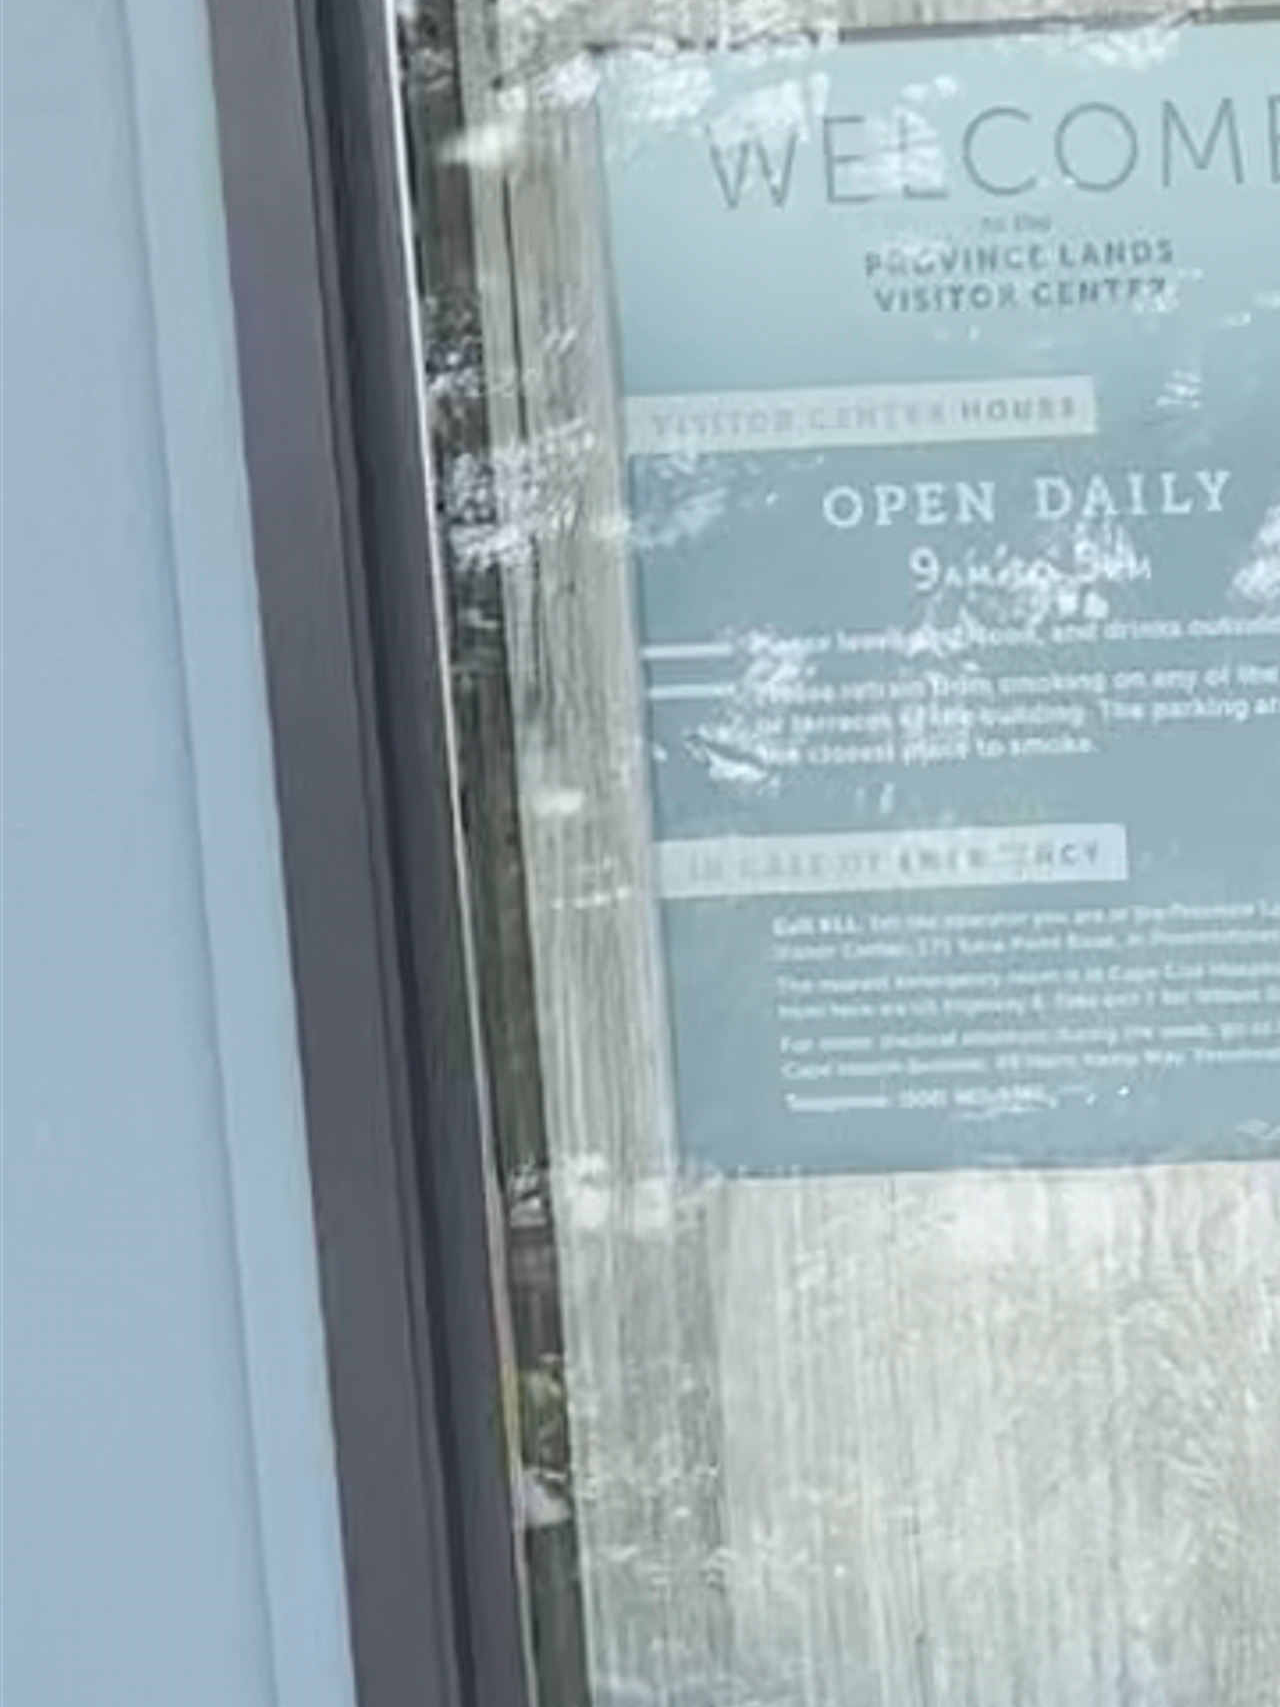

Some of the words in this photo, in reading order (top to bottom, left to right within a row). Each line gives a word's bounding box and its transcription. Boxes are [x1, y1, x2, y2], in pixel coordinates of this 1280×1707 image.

[863, 243, 1044, 276] PROVINCE
[1058, 238, 1175, 268] LANDS
[873, 281, 1019, 312] VISITOR
[1030, 277, 1170, 307] CENTER
[959, 395, 1076, 423] HOURS
[822, 479, 997, 529] OPEN
[1032, 467, 1231, 519] DAILY
[1151, 694, 1250, 723] parking
